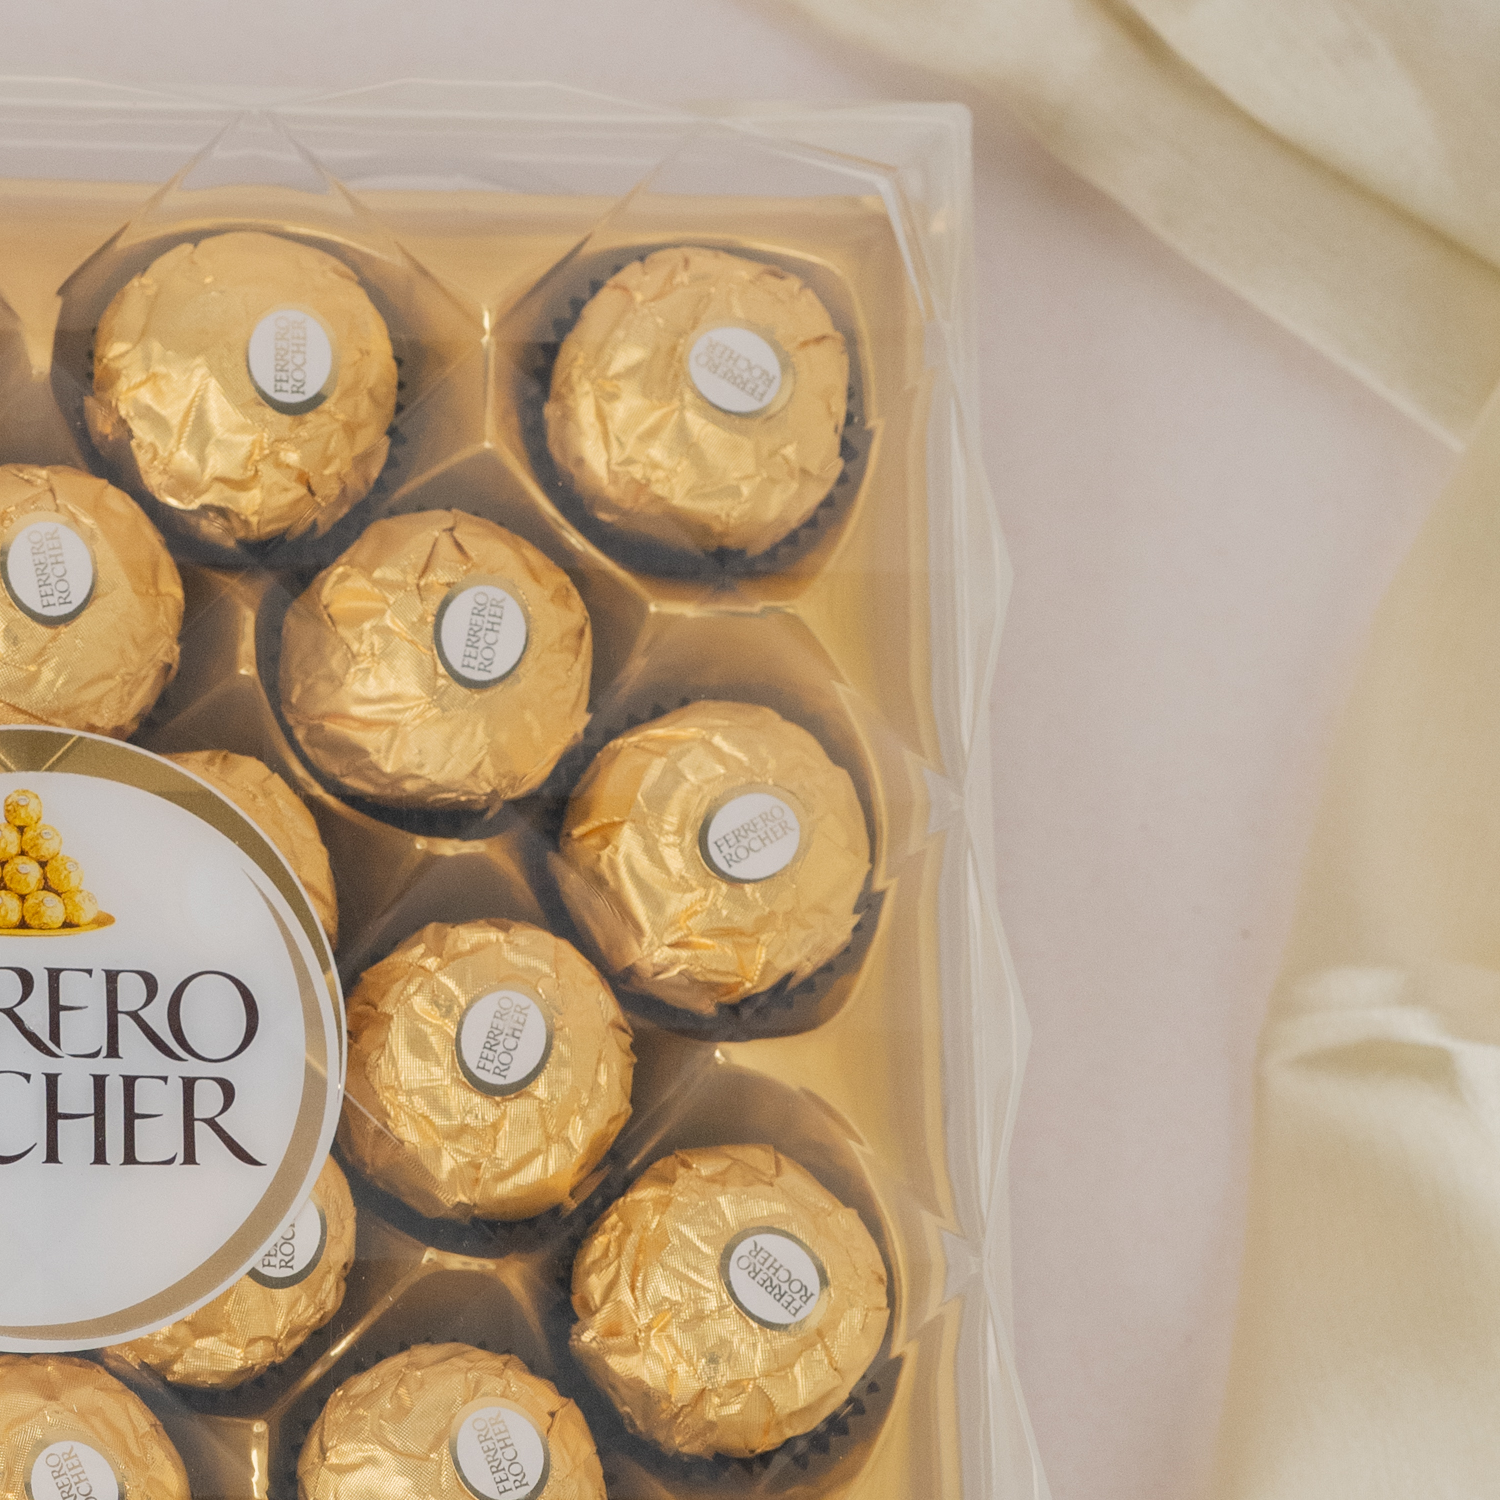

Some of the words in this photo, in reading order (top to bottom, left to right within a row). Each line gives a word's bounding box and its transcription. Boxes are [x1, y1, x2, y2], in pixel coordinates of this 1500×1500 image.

[273, 315, 288, 394] FERRERO
[290, 318, 306, 395] ROCHER
[28, 529, 56, 609] FERRERO
[45, 527, 72, 607] ROCHER
[461, 592, 489, 671] FERRERO
[477, 596, 506, 675] ROCHER
[713, 805, 785, 854] FERRERO
[722, 819, 796, 869] ROCHER
[476, 996, 514, 1073] FERRERO
[492, 1002, 531, 1080] ROCHER
[279, 1217, 296, 1271] ROC
[748, 1240, 816, 1306] ROCHER
[736, 1255, 803, 1318] FERRERO
[471, 1417, 512, 1496] FERRERO
[488, 1410, 530, 1489] ROCHER
